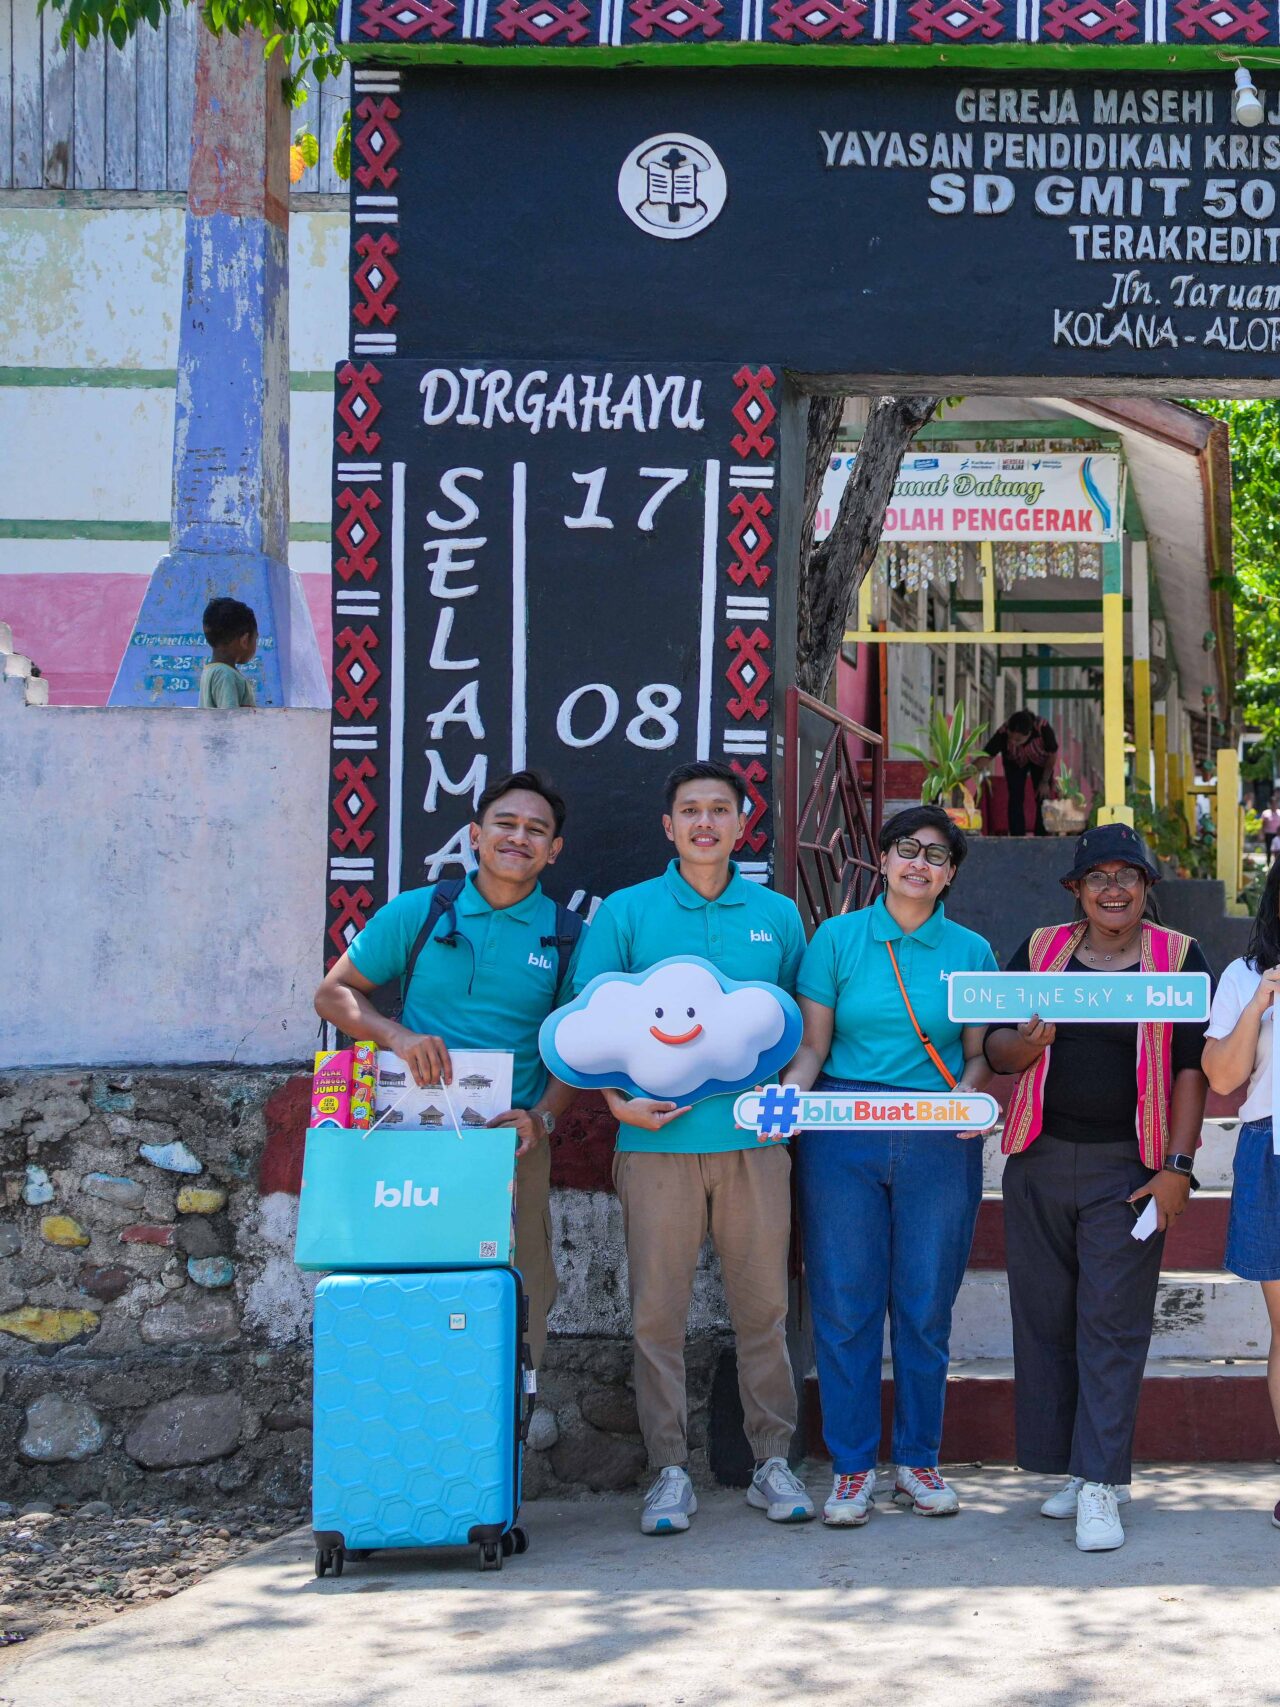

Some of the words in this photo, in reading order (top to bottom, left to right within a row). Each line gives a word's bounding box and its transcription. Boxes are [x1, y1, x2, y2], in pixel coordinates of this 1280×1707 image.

[955, 88, 1080, 124] GEREJA
[1094, 89, 1213, 124] MASEHI
[819, 131, 973, 168] YAYASAN
[985, 133, 1191, 169] PENDIDIKAN
[928, 173, 1015, 215] SD
[1035, 175, 1190, 217] GMIT
[1203, 178, 1275, 219] 50
[1054, 309, 1178, 348] KOLANA
[420, 368, 705, 434] DIRGAHAYU
[953, 508, 1093, 532] PENGGERAK
[557, 683, 682, 749] 08
[750, 929, 773, 943] blu
[527, 952, 552, 969] blu
[963, 988, 1006, 1009] ONE
[1074, 987, 1113, 1008] SKY
[1146, 985, 1193, 1007] blu
[313, 1085, 347, 1094] JUMBO
[757, 1088, 971, 1134] #bluBuatBaik
[374, 1180, 439, 1208] blu
